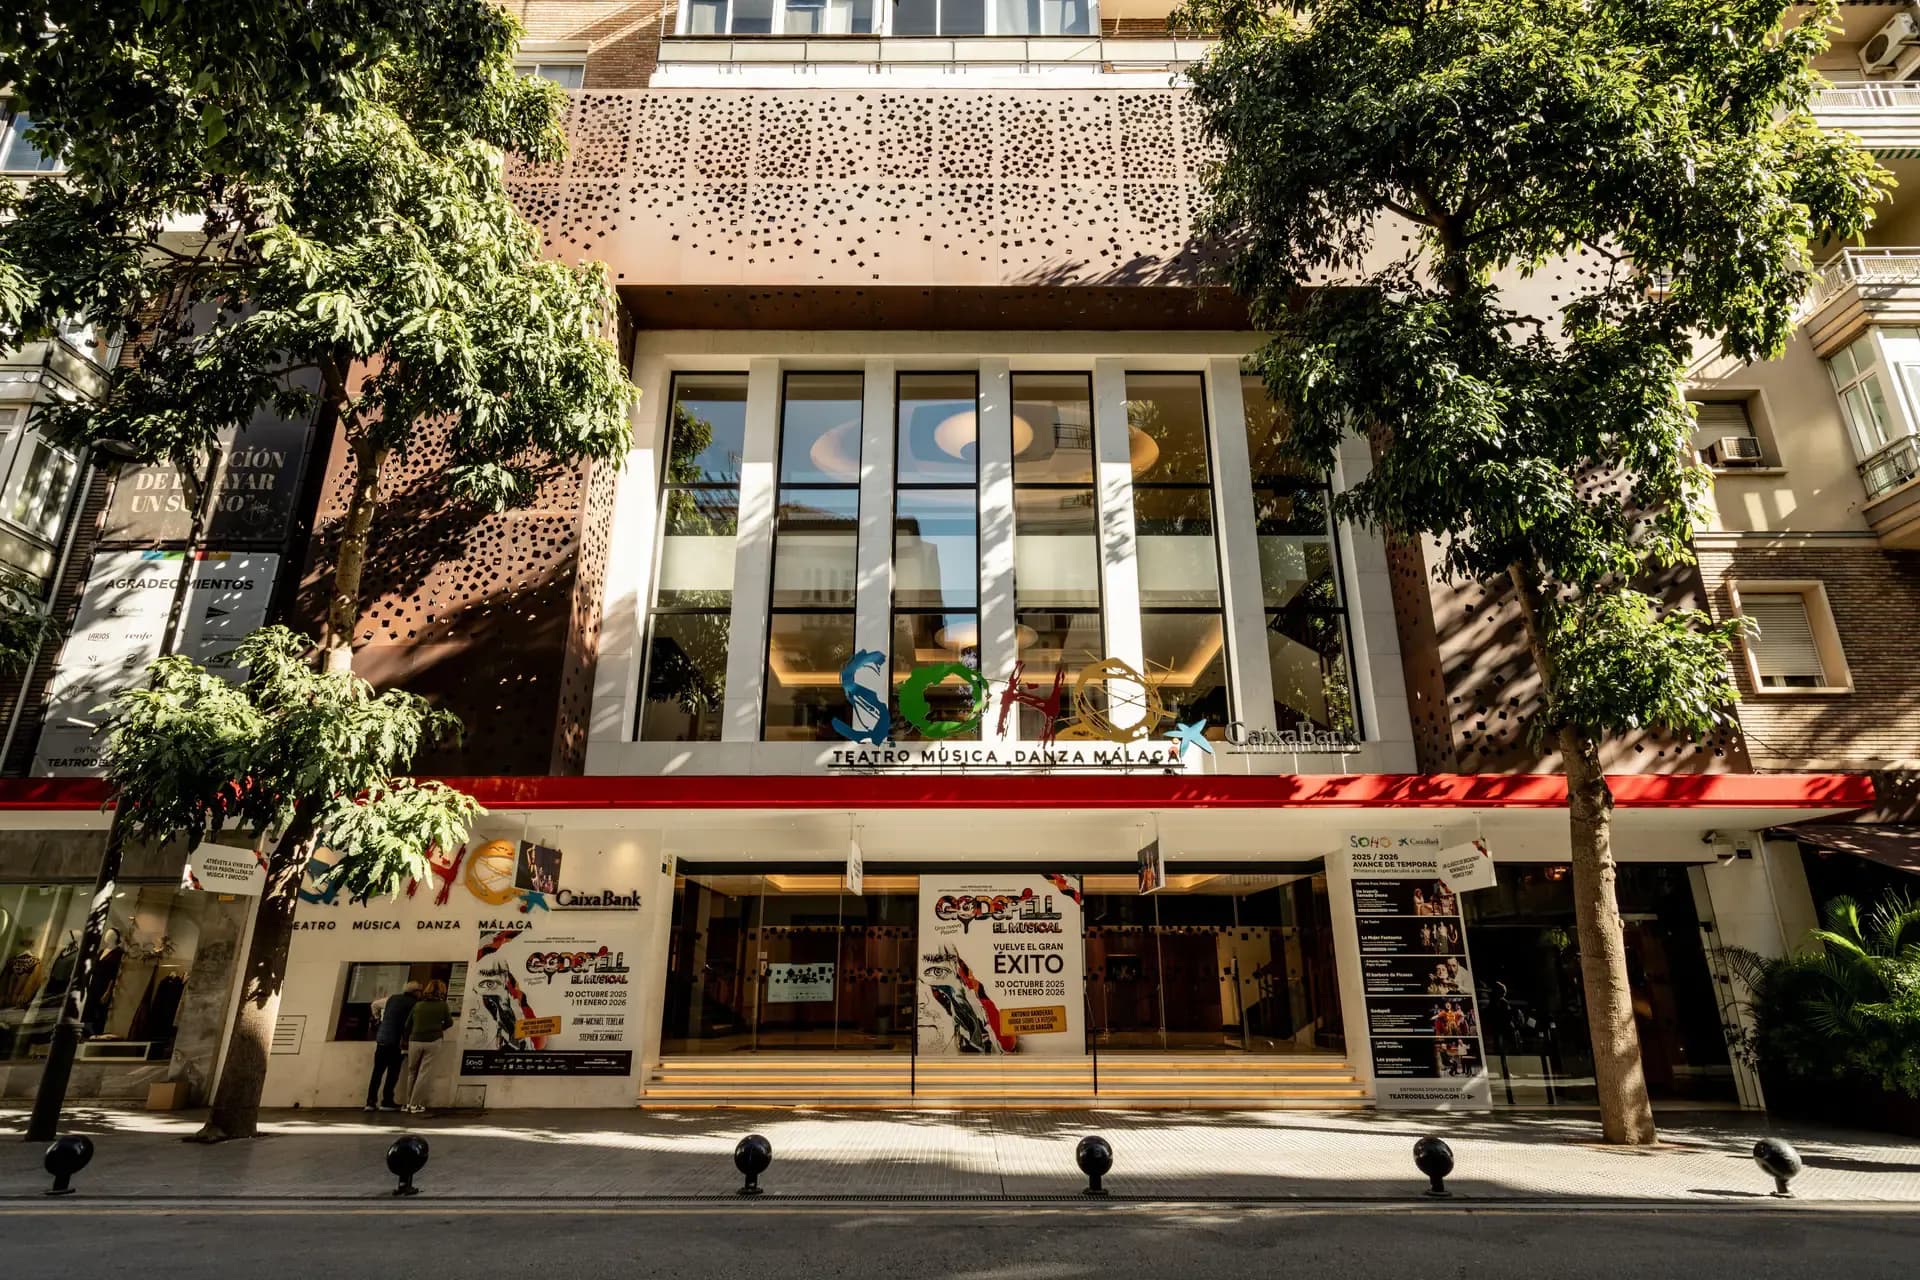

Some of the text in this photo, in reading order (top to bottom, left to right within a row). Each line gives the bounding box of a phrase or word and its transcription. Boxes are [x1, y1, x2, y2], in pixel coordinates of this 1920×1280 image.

[136, 472, 168, 490] DE
[131, 494, 162, 513] UN
[105, 578, 254, 590] AGRADECMIENTOS
[831, 648, 1177, 749] SOHO
[1225, 721, 1361, 745] CaixaBank
[833, 746, 1180, 763] TEATRO MÚSICA DANZA MÁLAGA
[1350, 835, 1392, 849] SOHO
[555, 889, 642, 907] CaixaBank
[291, 919, 533, 930] EATRO MÚSICA DANZA MÁLAGA
[992, 922, 1063, 934] EL MUSICAL
[993, 943, 1064, 951] VUELVE EL GRAN
[994, 952, 1064, 974] ÉXITO
[571, 975, 629, 985] EL MUSICAL
[994, 980, 1065, 988] 30 OCTUBRE 2025
[564, 990, 628, 998] 30 OCTUBRE 2025
[1008, 988, 1016, 996] 11
[1017, 988, 1044, 996] ENERO
[1045, 988, 1065, 996] 2026
